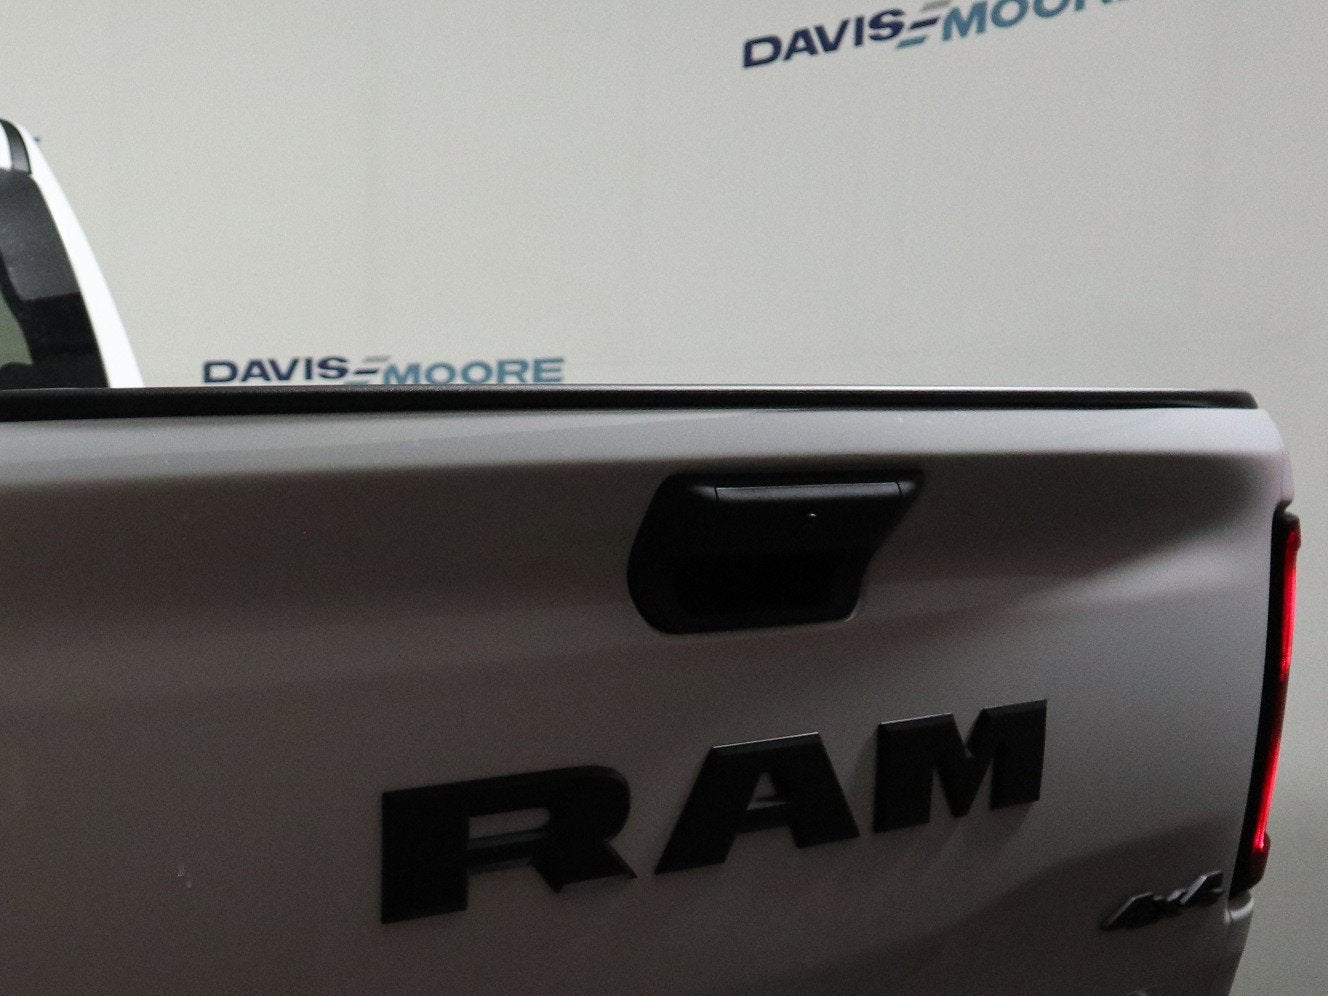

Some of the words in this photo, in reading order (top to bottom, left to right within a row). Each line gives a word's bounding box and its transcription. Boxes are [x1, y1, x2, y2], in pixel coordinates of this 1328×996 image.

[741, 8, 907, 68] DAVIS
[940, 0, 1122, 41] MOO
[202, 355, 349, 383] DAVIS
[381, 357, 565, 384] MOORE
[381, 699, 1048, 924] RAM
